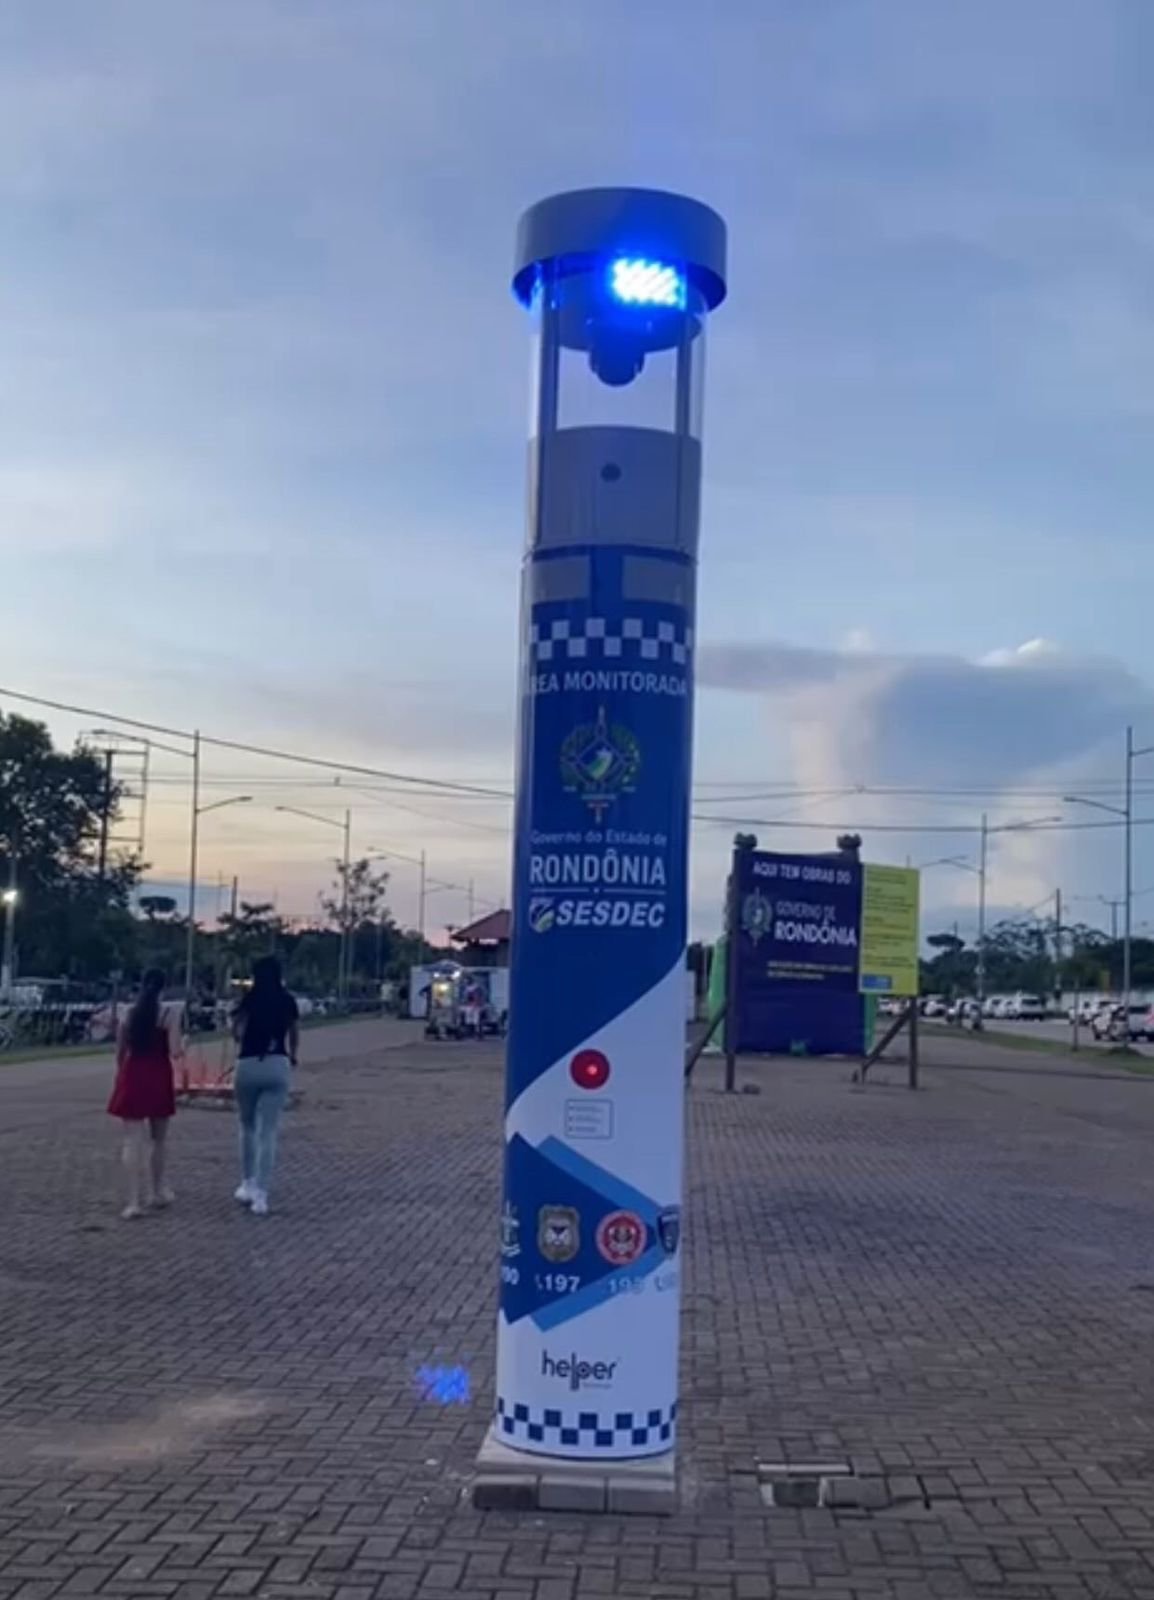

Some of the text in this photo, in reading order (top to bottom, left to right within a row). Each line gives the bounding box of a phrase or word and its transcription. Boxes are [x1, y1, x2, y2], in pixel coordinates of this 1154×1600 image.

[531, 828, 668, 847] Governo do Estado de
[529, 848, 666, 886] RONDÔNIA
[753, 861, 778, 878] AQUI
[780, 863, 801, 879] TEM
[801, 865, 835, 883] OBRAS
[555, 899, 666, 928] SESDEC
[775, 900, 822, 920] GOVERNO
[774, 919, 857, 946] RONDÔNIA
[544, 1273, 581, 1293] 197
[541, 1348, 618, 1392] helper
